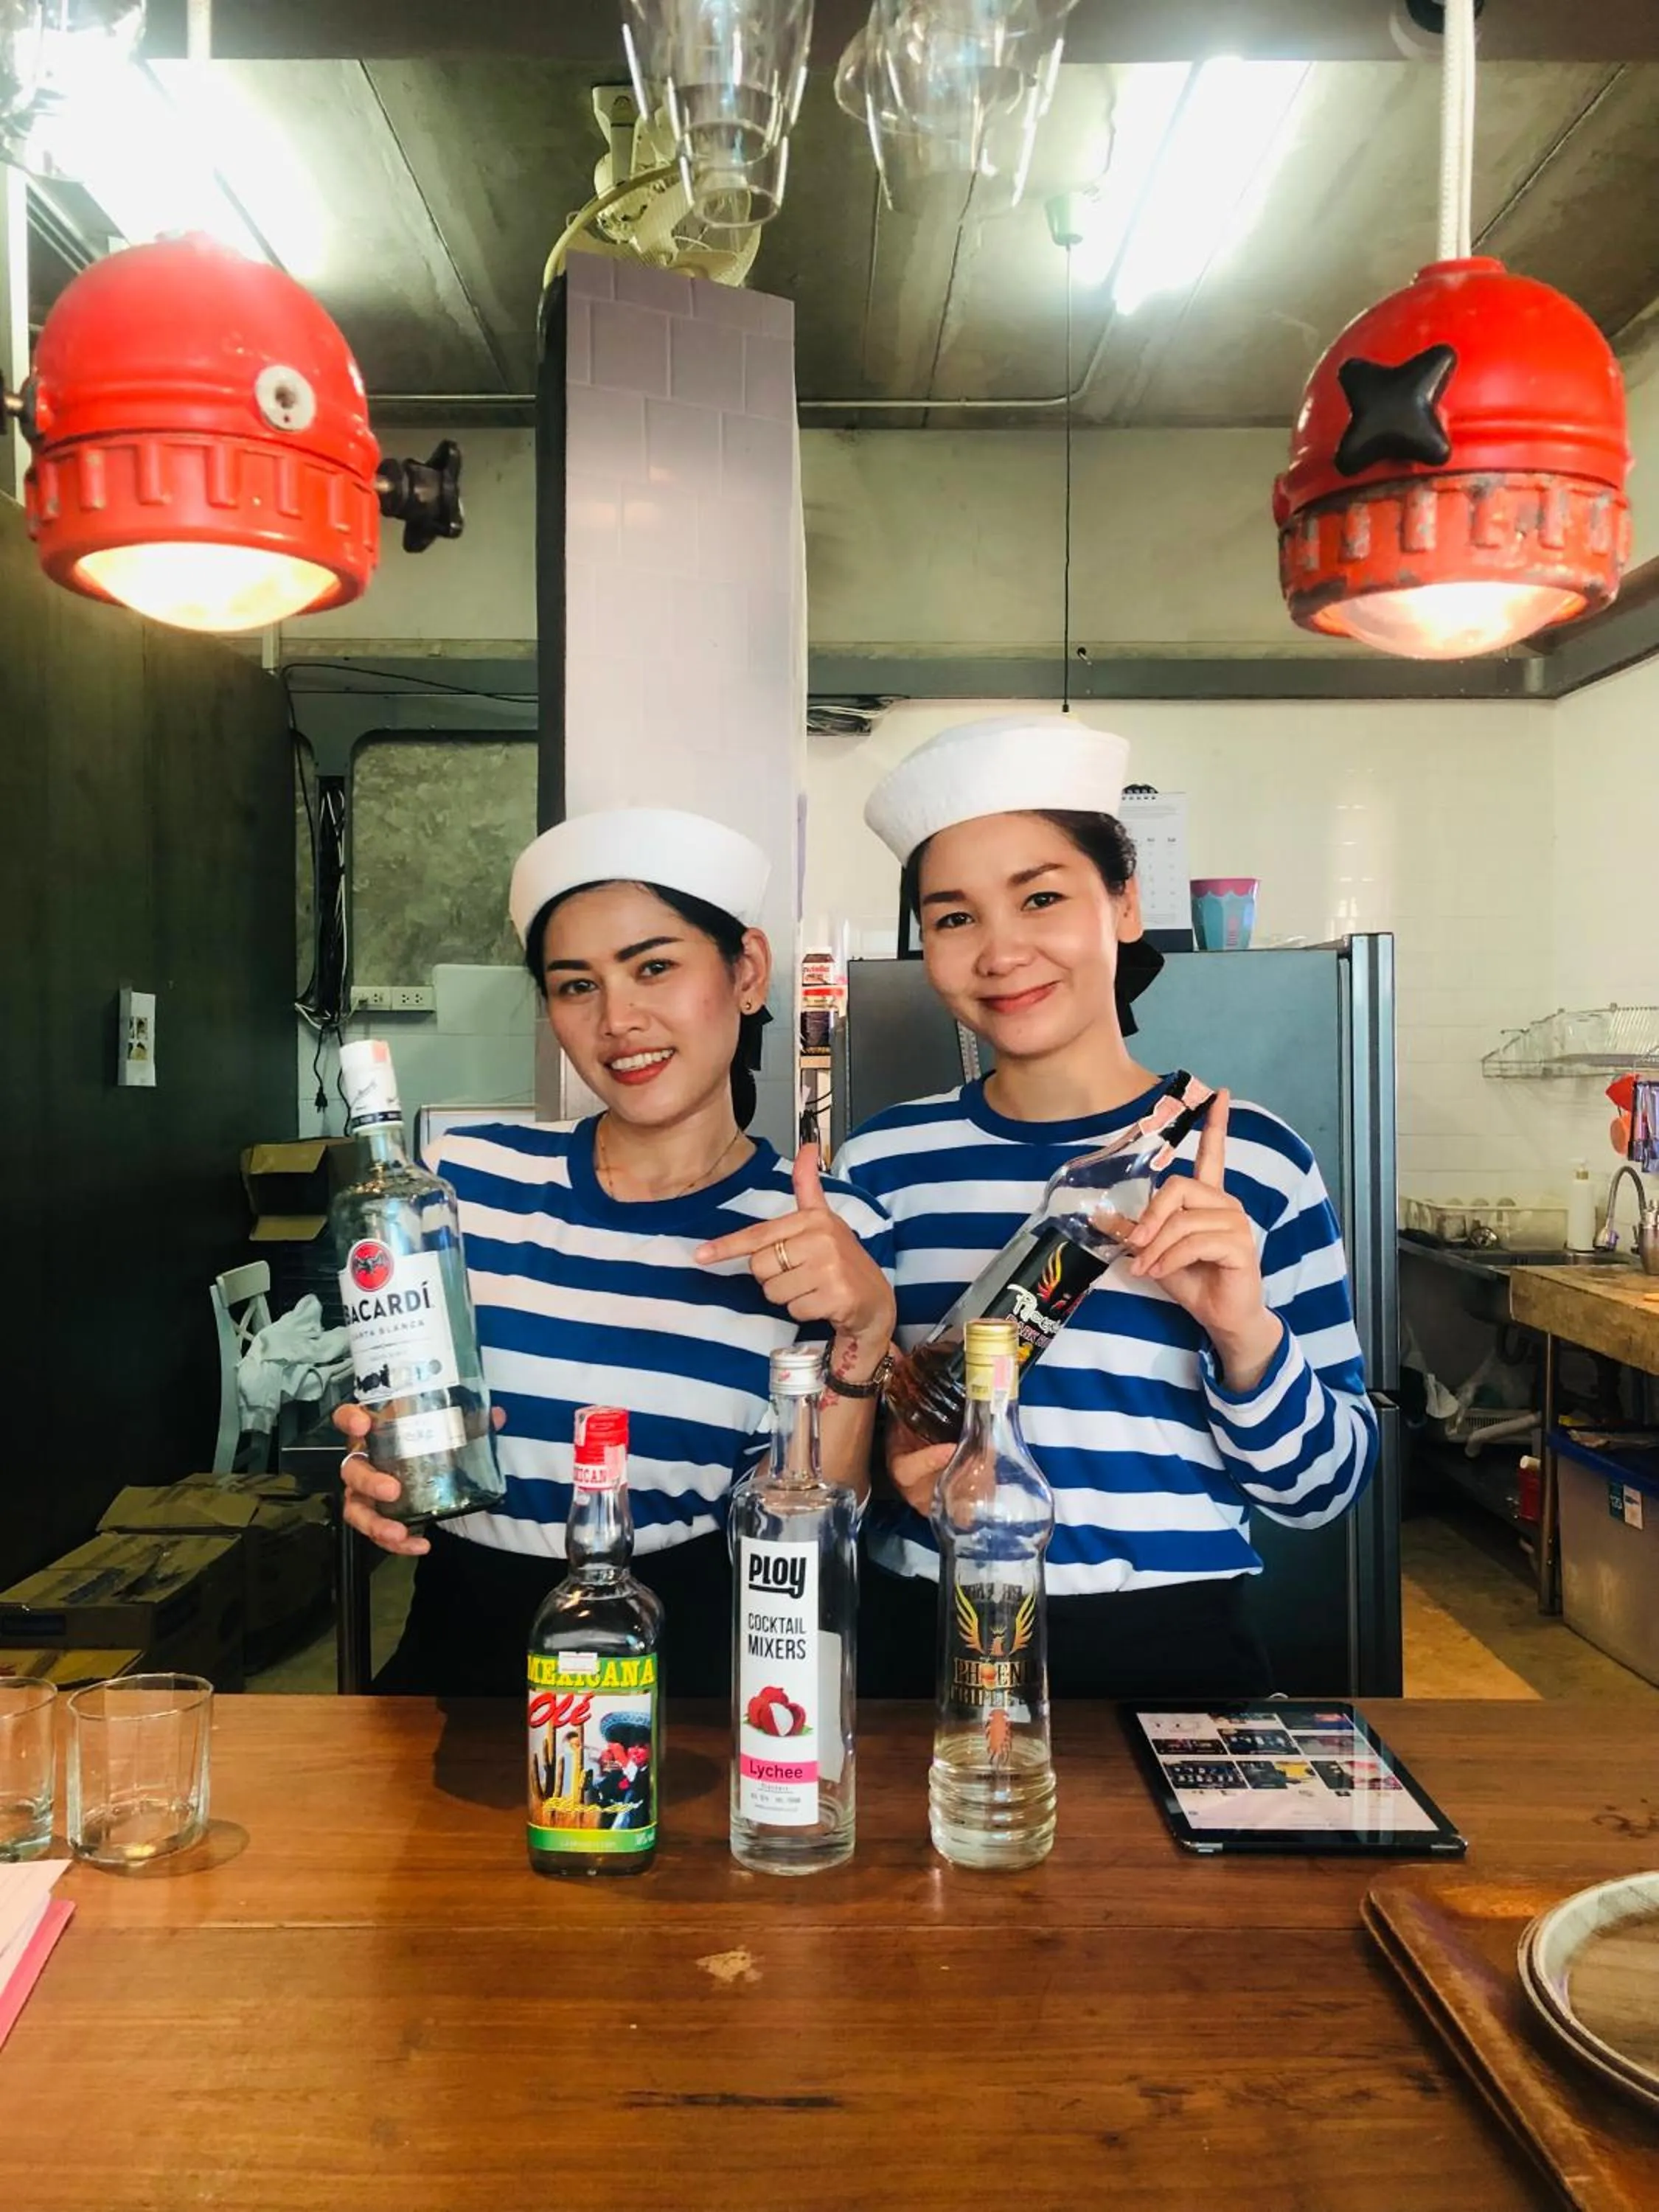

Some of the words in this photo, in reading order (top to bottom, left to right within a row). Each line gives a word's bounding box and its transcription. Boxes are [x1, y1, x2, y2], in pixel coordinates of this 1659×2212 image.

[748, 1613, 807, 1635] COCKTAIL
[748, 1633, 807, 1660] MIXERS
[529, 1690, 596, 1728] Olé
[750, 1760, 803, 1779] Lychee
